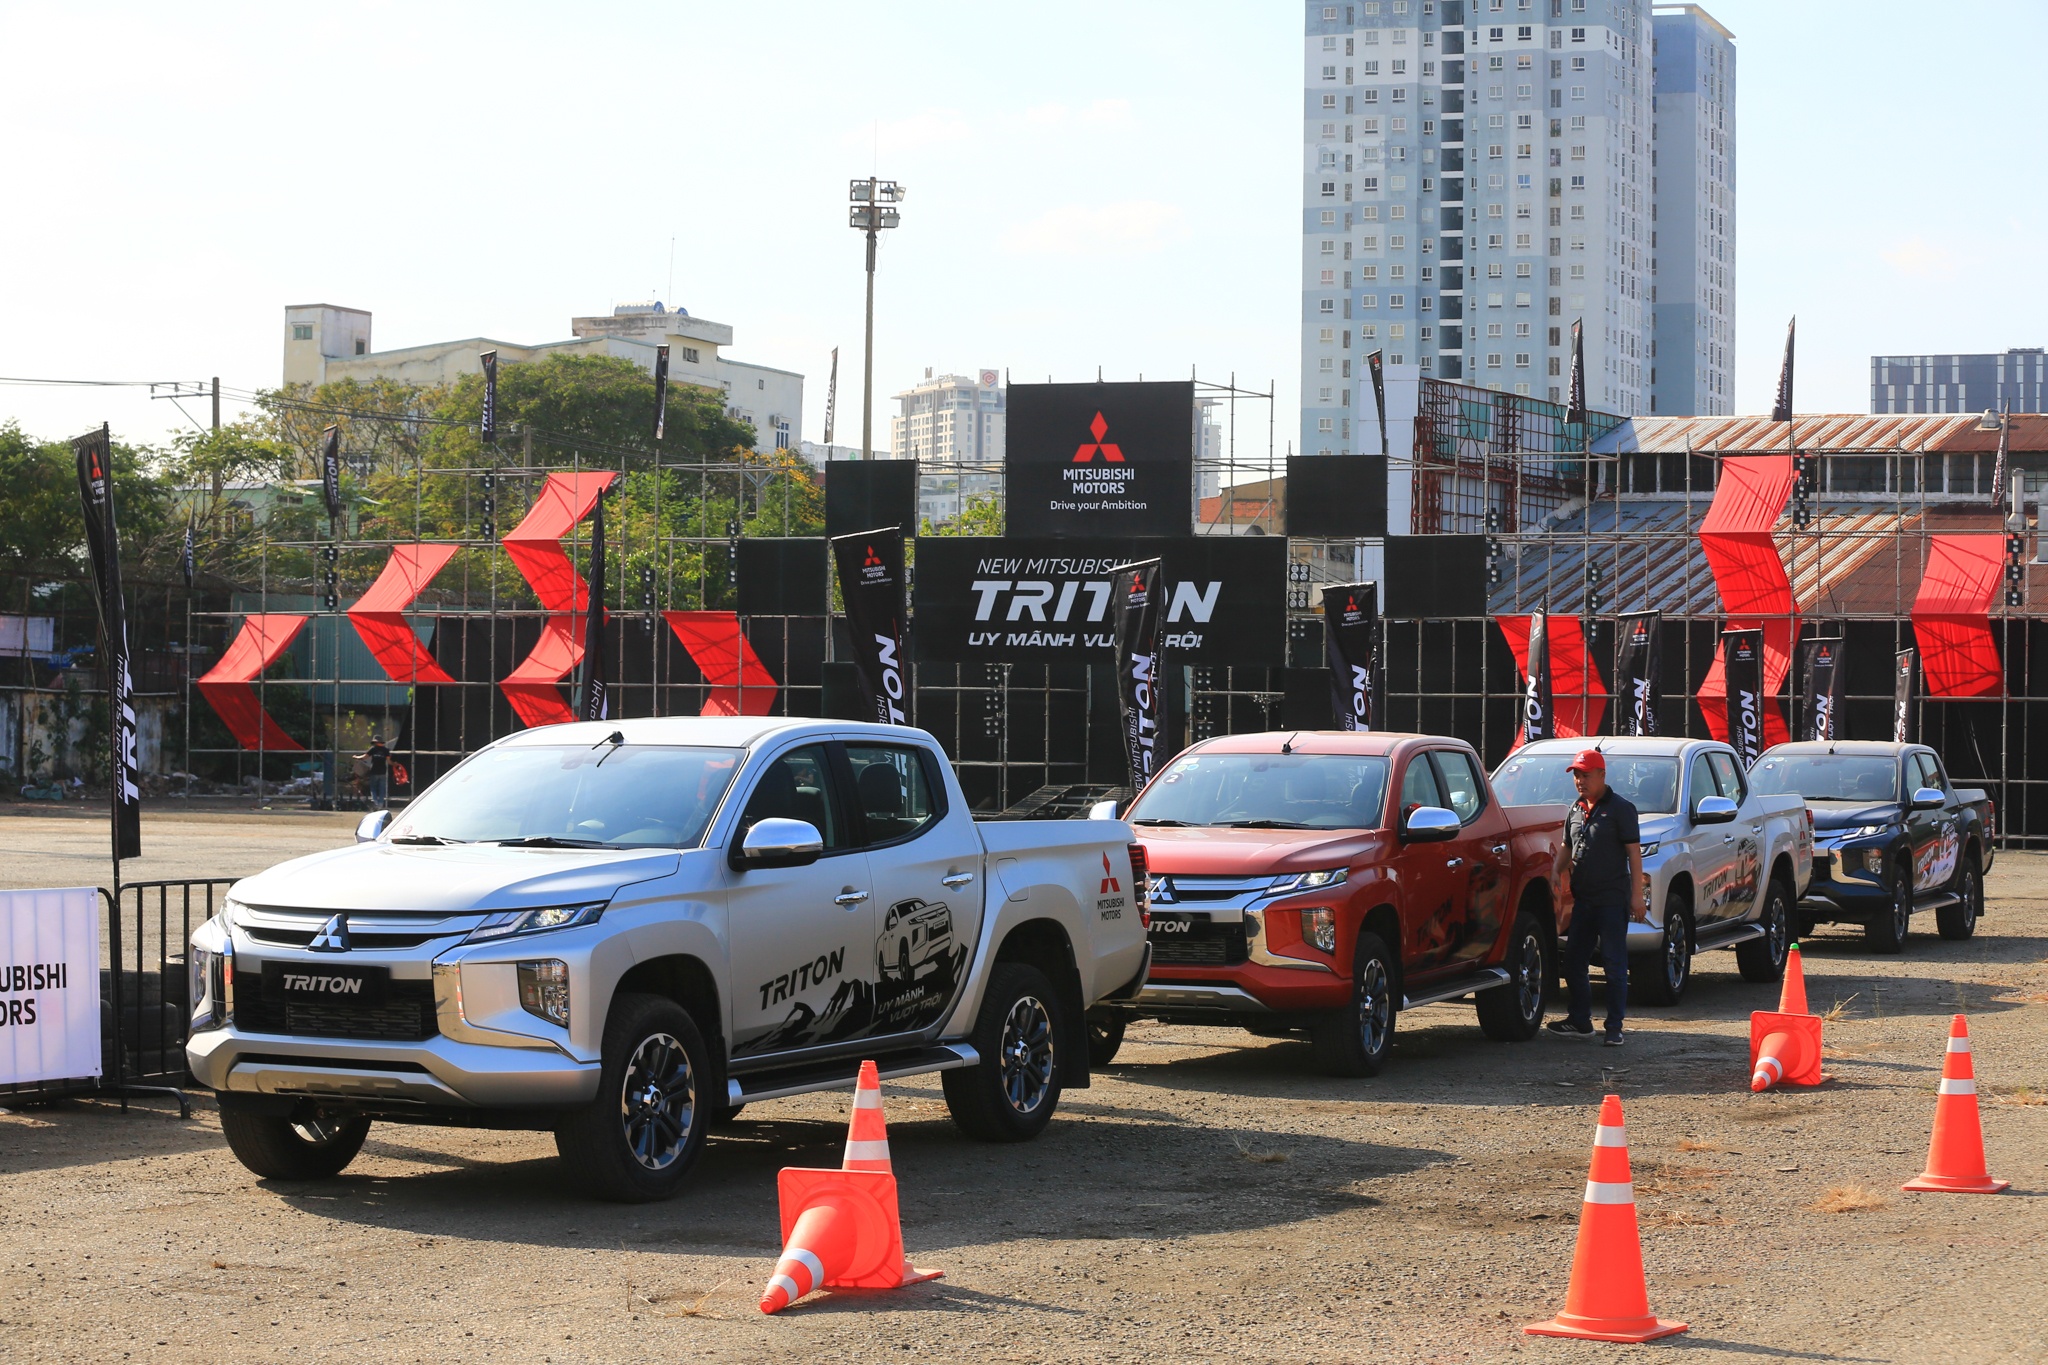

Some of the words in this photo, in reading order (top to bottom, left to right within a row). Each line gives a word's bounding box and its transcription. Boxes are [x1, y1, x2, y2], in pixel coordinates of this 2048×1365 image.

[1063, 468, 1135, 480] MITSUBISHI
[1072, 482, 1125, 494] MOTORS
[1050, 500, 1076, 510] Drive
[1078, 502, 1100, 512] your
[1101, 500, 1147, 510] Ambition
[862, 565, 886, 574] MITSUBISHI
[977, 558, 1022, 575] NEW
[866, 571, 884, 579] MOTORS
[971, 580, 1222, 623] TRITN
[968, 632, 1001, 646] UY
[1005, 630, 1076, 647] MÃNH
[1164, 630, 1203, 650] RỘI
[115, 653, 124, 752] MITSUBISHI
[121, 657, 140, 806] TRIT
[1165, 774, 1179, 783] 2
[1097, 897, 1125, 910] MITSUBISHI
[1100, 909, 1122, 921] MOTORS
[283, 973, 362, 994] TRITON
[759, 945, 845, 1011] TRITON
[878, 999, 894, 1015] UY
